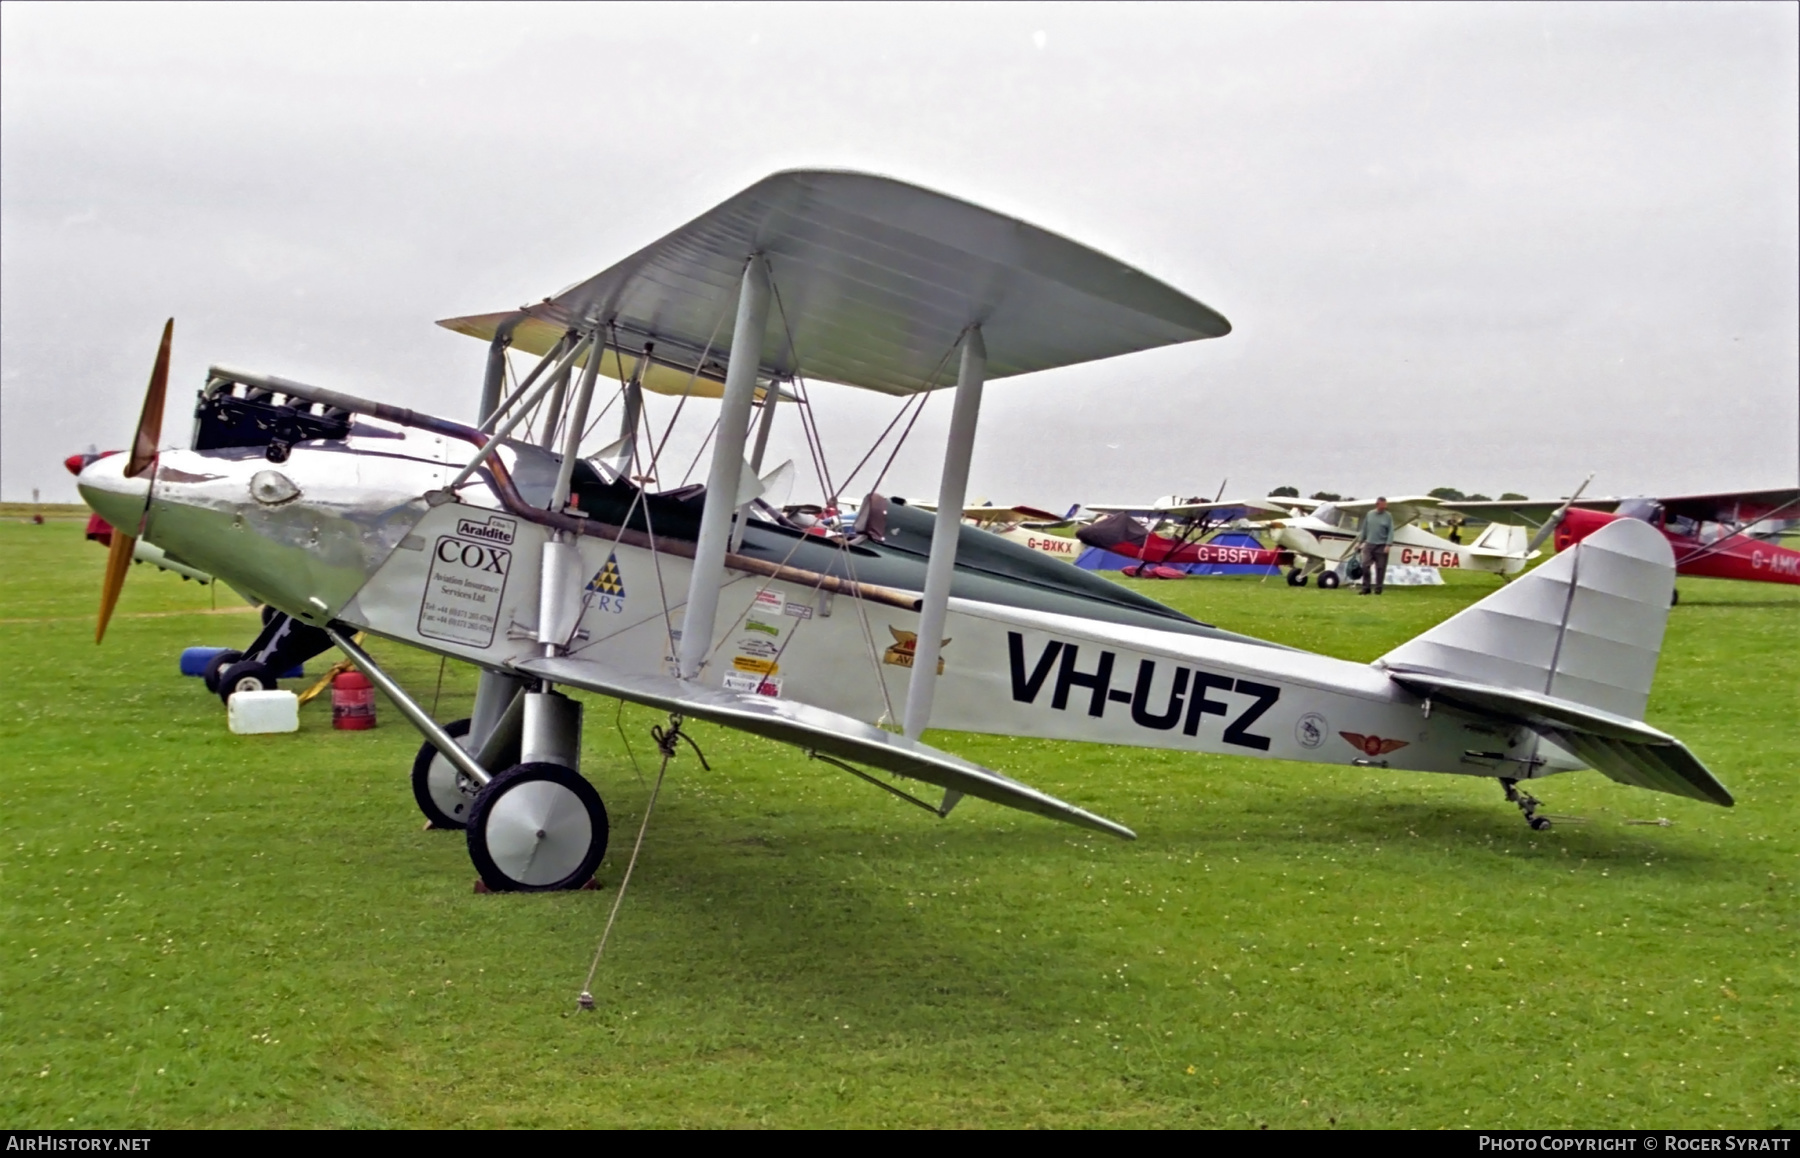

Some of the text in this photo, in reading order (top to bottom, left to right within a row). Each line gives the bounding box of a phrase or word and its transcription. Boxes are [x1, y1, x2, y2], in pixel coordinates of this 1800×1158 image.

[460, 523, 511, 541] Araldite
[1028, 537, 1073, 554] G-BXKX
[438, 540, 508, 575] COX
[1197, 546, 1259, 565] G-BSFV
[1401, 547, 1460, 569] G-ALGA
[434, 573, 500, 593] Aviation Insurance
[441, 586, 471, 600] Services
[1007, 631, 1281, 751] VH-UFZ
